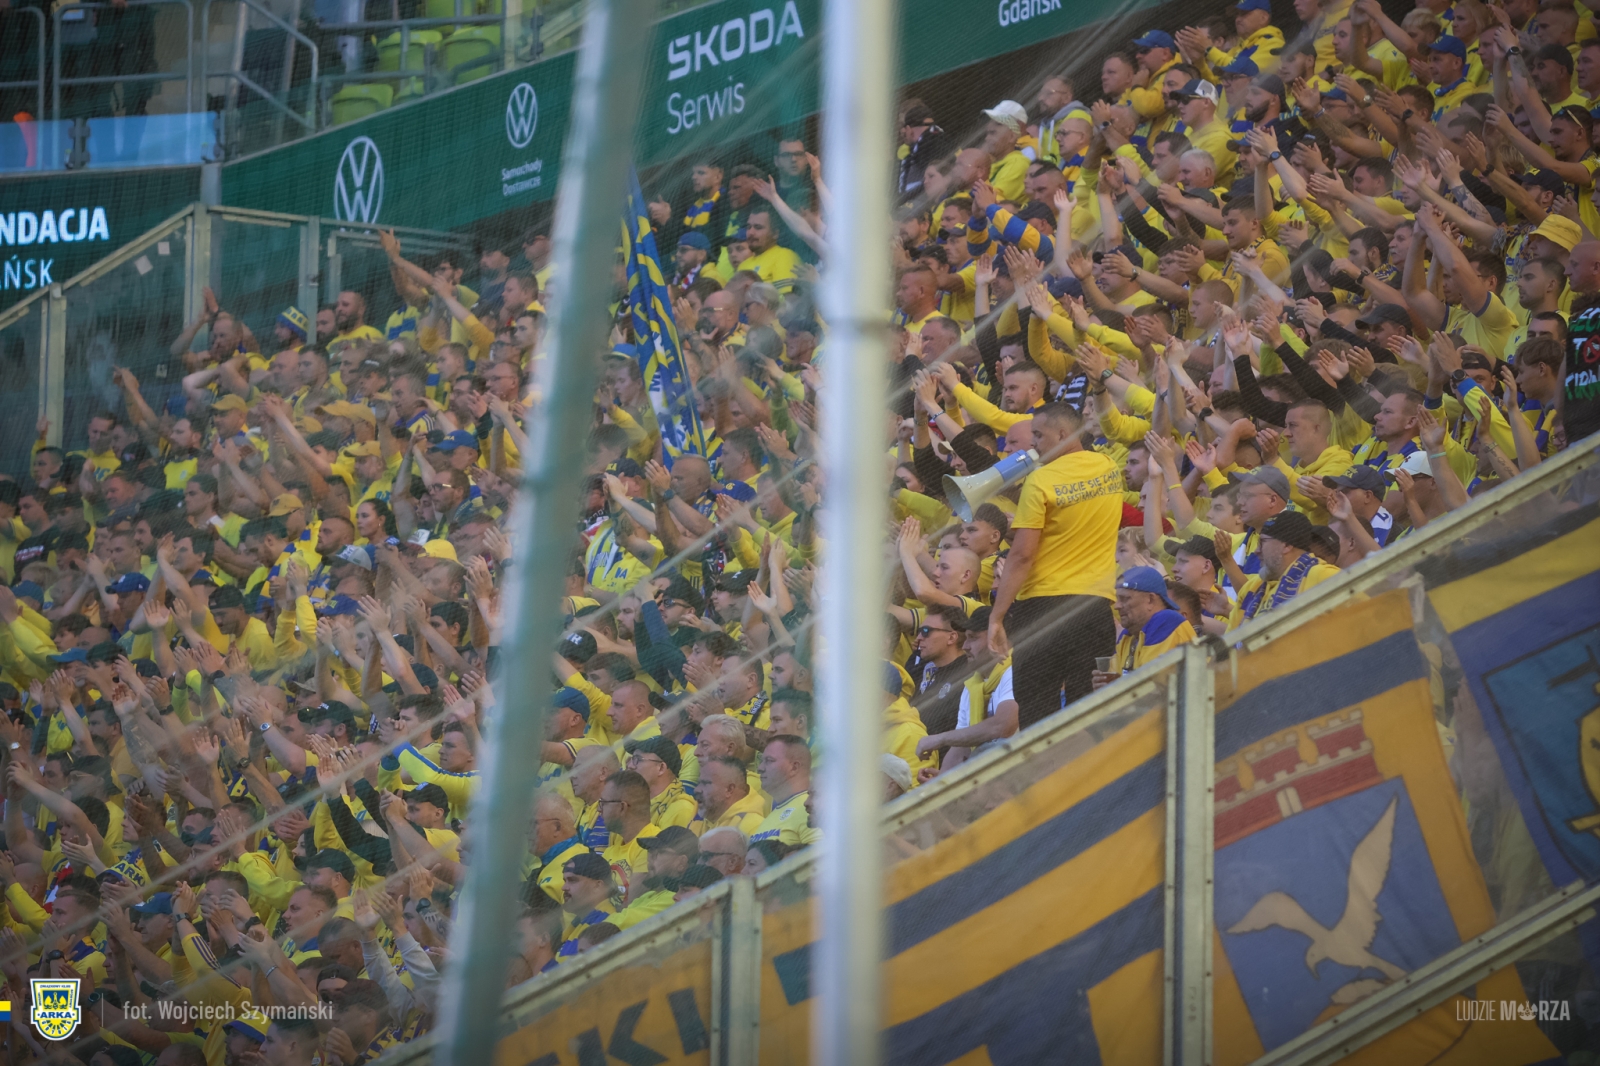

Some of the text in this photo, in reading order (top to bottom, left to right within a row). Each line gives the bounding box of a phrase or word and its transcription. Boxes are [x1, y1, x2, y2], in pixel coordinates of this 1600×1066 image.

[667, 75, 745, 134] Serwis
[0, 206, 110, 246] NDACJA
[0, 254, 54, 290] ŃSK
